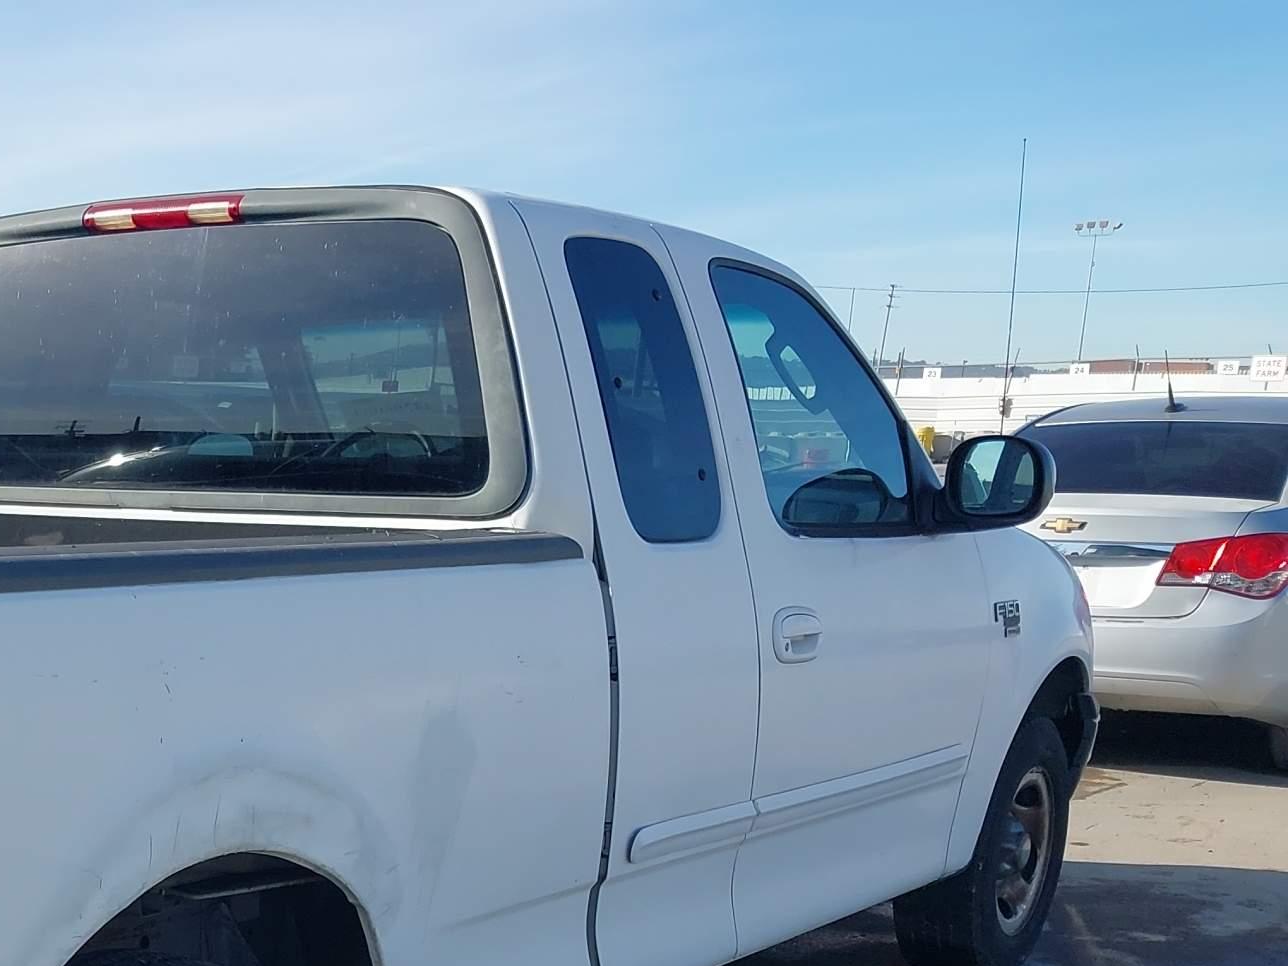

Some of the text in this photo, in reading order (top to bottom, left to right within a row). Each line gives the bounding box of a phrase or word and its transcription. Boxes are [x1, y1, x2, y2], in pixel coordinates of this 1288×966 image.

[1223, 363, 1234, 372] 25
[1255, 359, 1283, 368] STATE
[926, 369, 937, 378] 23
[1073, 366, 1085, 375] 24
[1255, 369, 1280, 378] FARM
